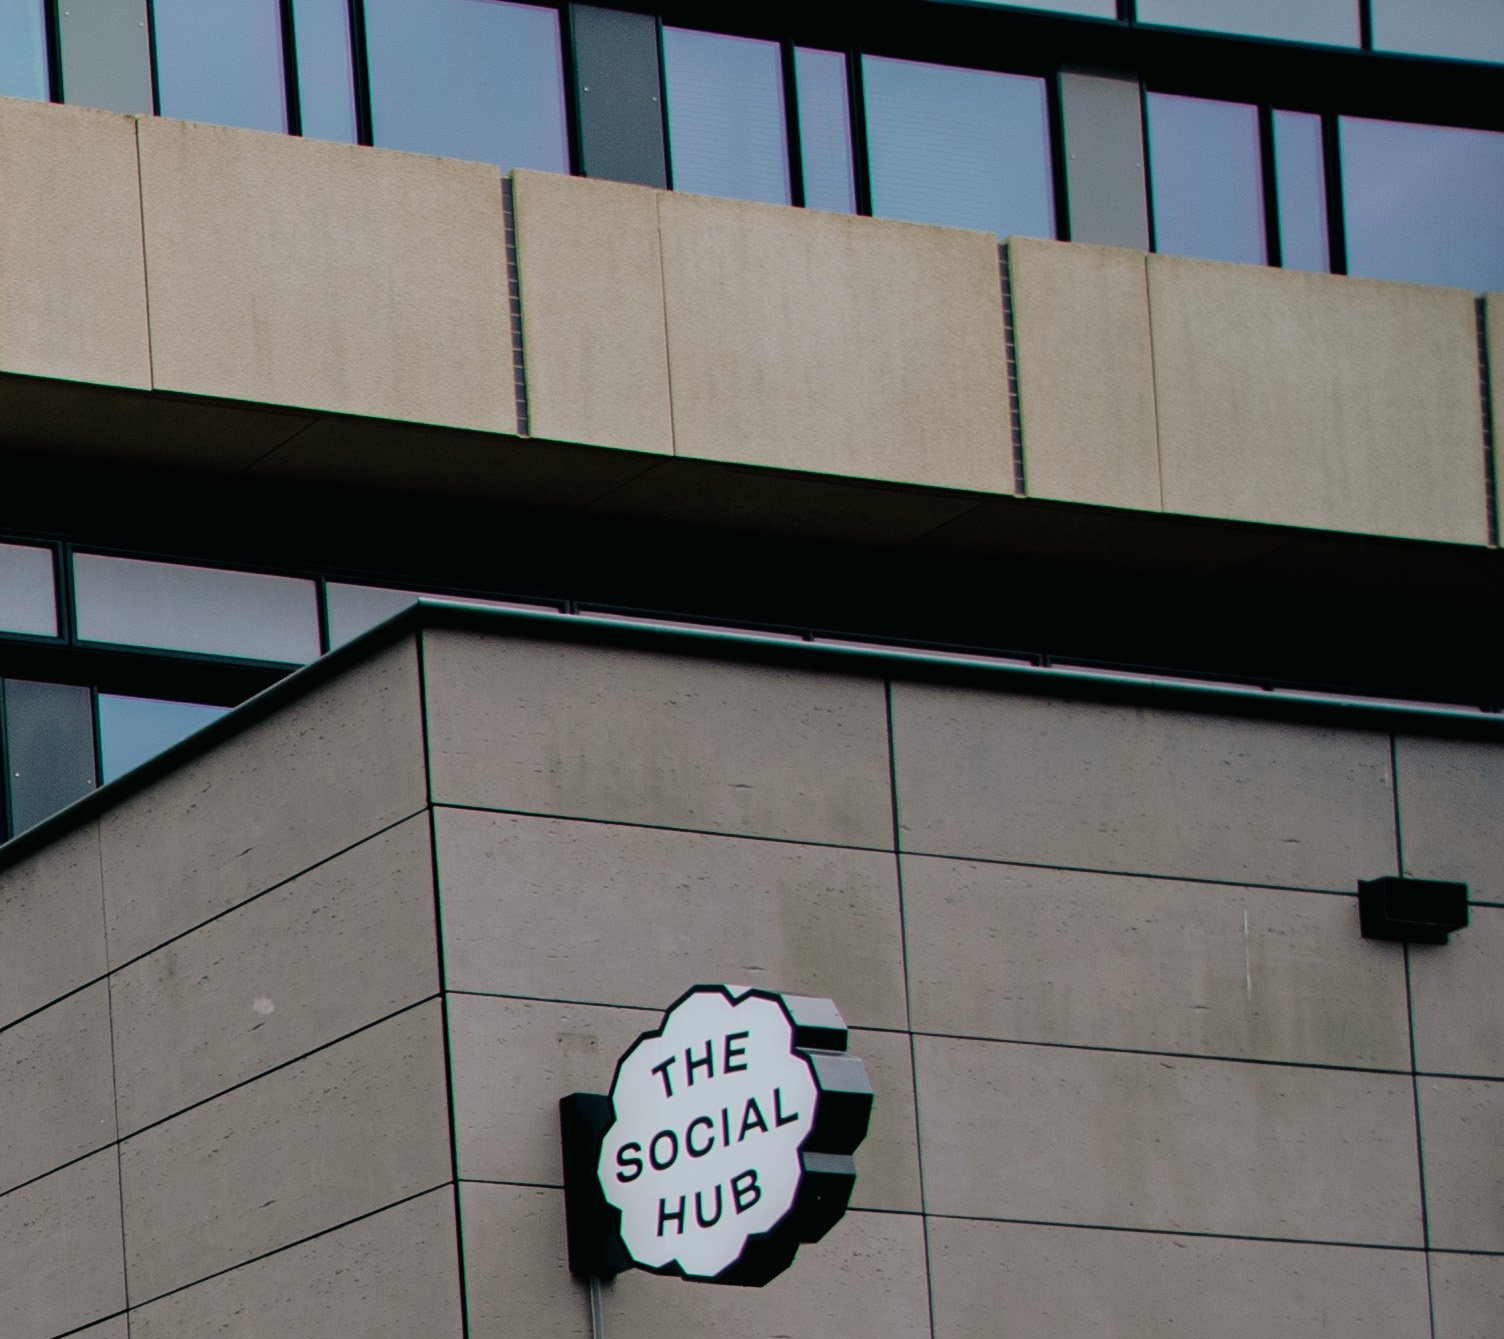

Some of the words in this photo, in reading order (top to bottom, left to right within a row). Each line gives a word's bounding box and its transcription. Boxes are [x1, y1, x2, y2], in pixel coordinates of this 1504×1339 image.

[650, 1030, 750, 1099] THE
[615, 1087, 800, 1183] SOCIAL
[656, 1168, 763, 1237] HUB
